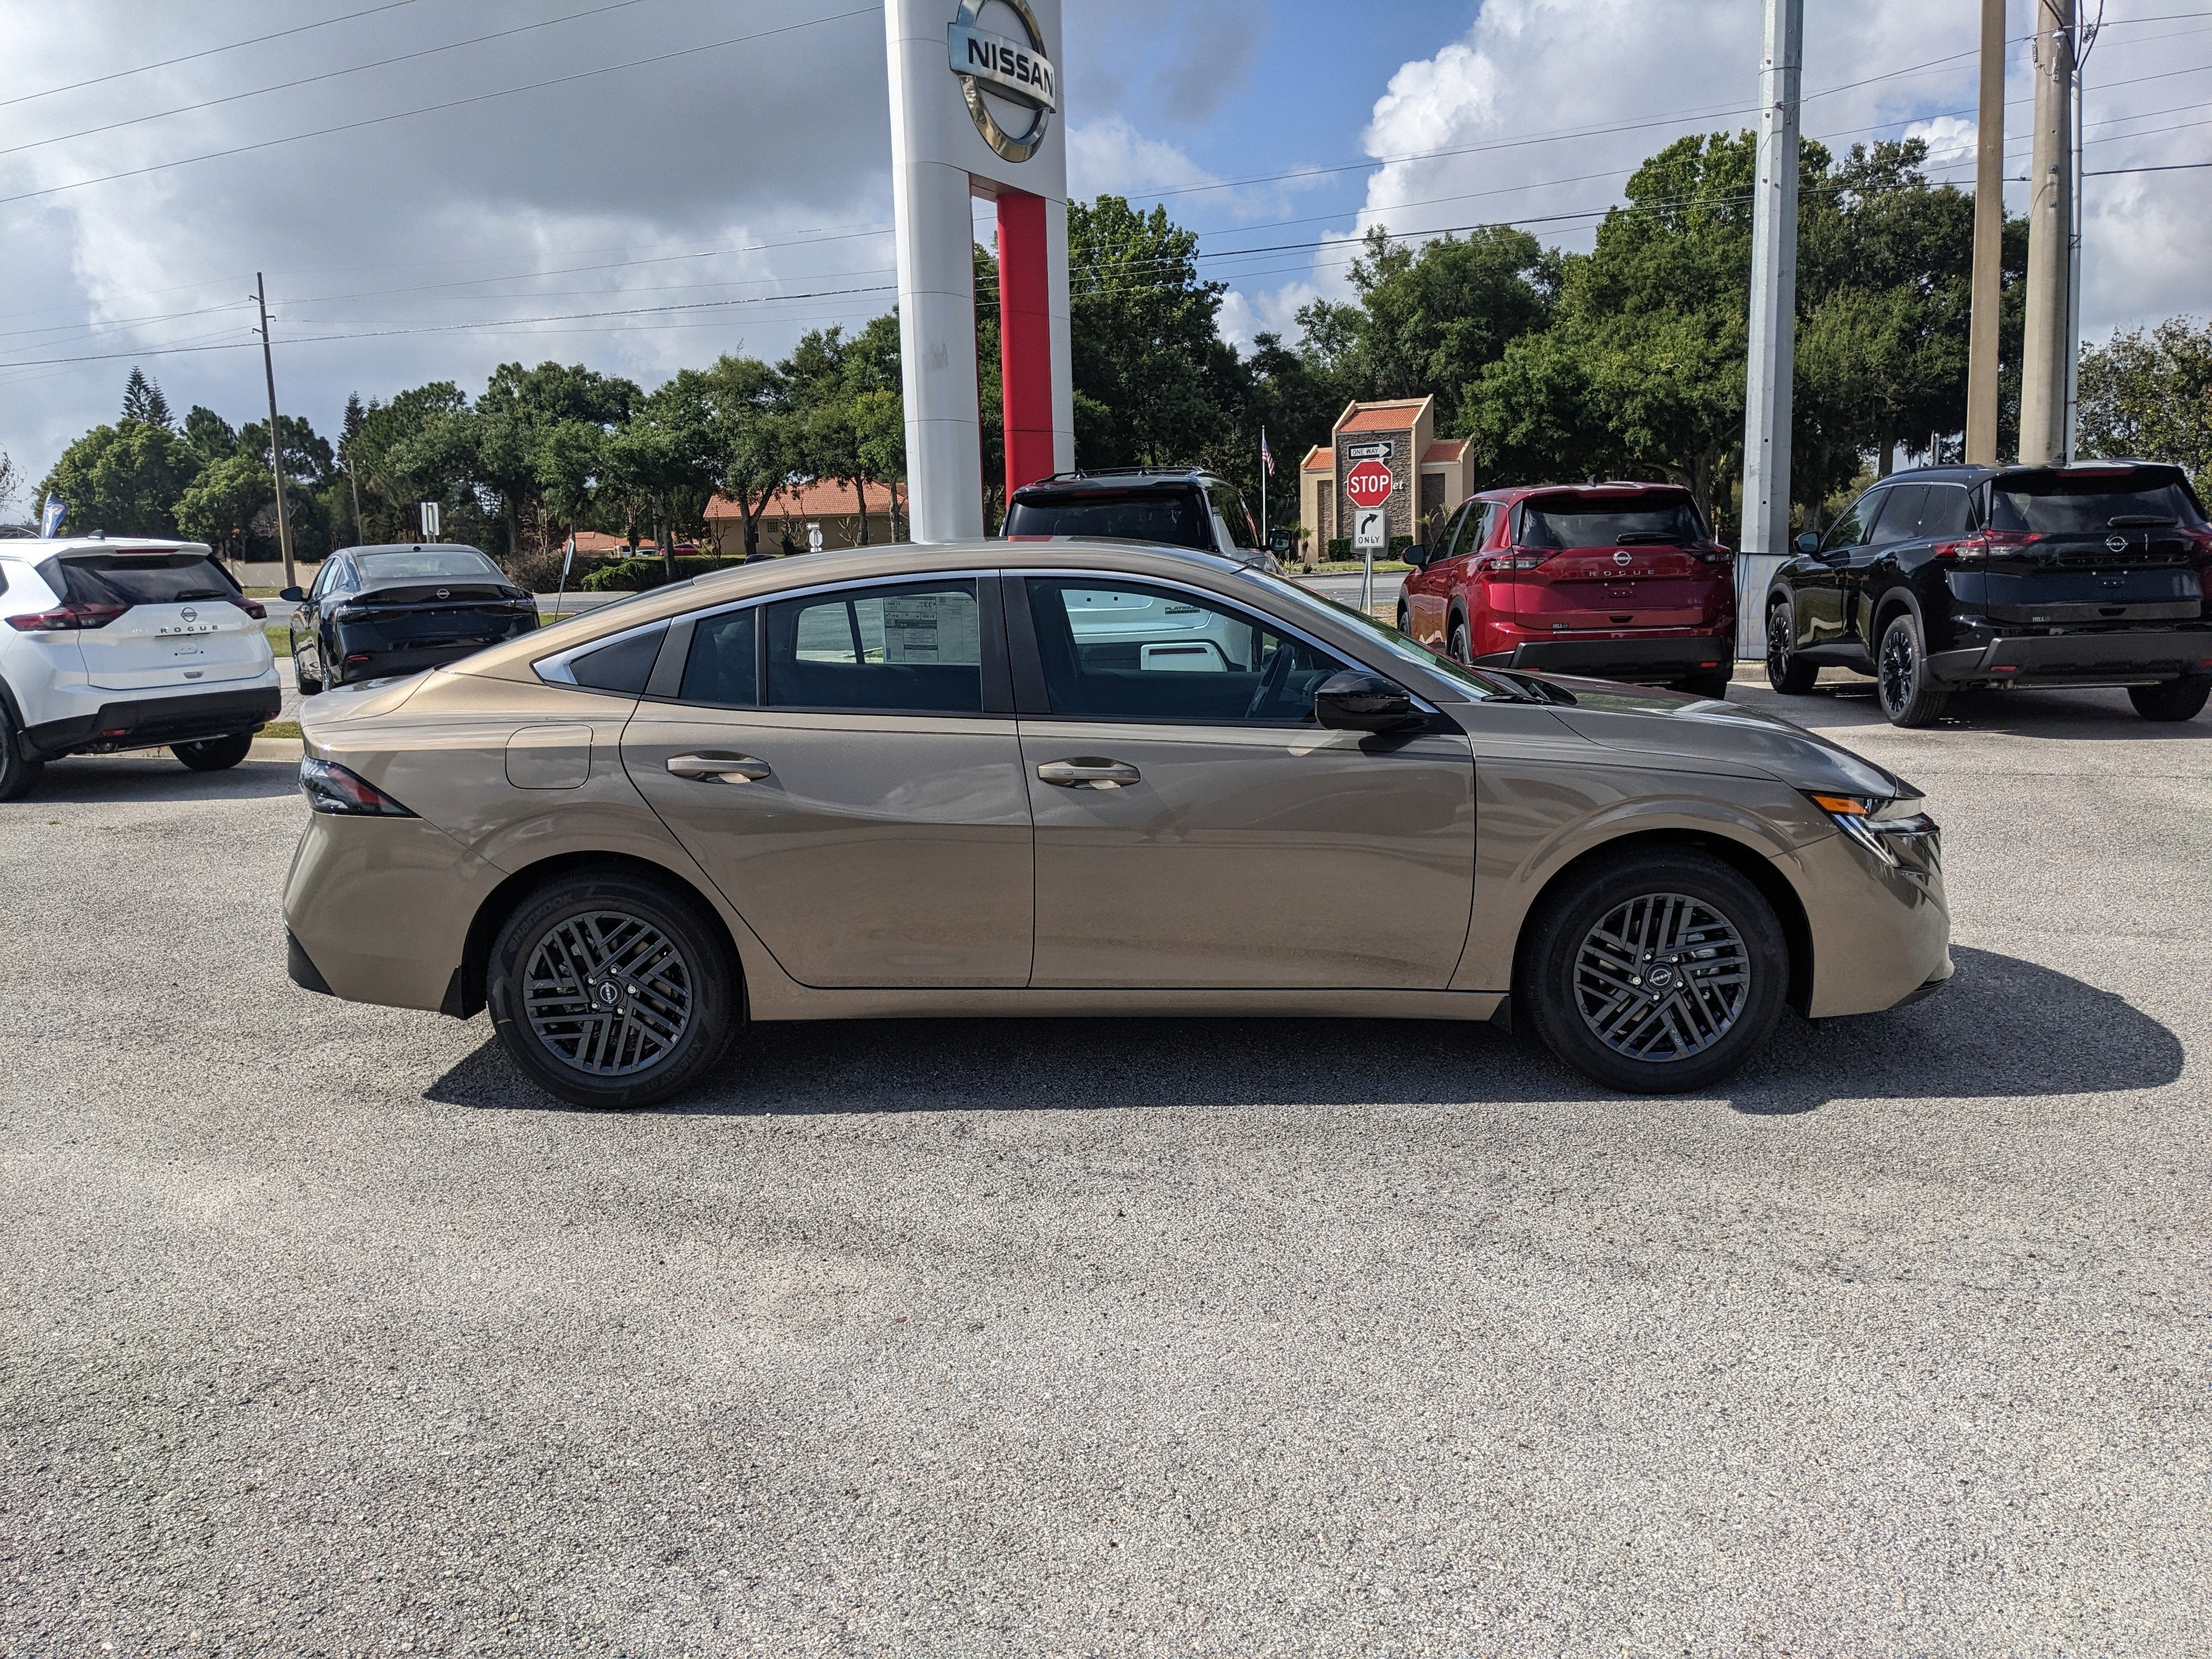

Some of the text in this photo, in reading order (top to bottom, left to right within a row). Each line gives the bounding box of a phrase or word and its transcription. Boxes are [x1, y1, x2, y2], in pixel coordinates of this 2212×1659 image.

[968, 37, 1054, 98] NISSAN
[1350, 475, 1389, 494] STOP
[161, 625, 219, 634] ROGUE
[1649, 971, 1672, 983] NISSAN
